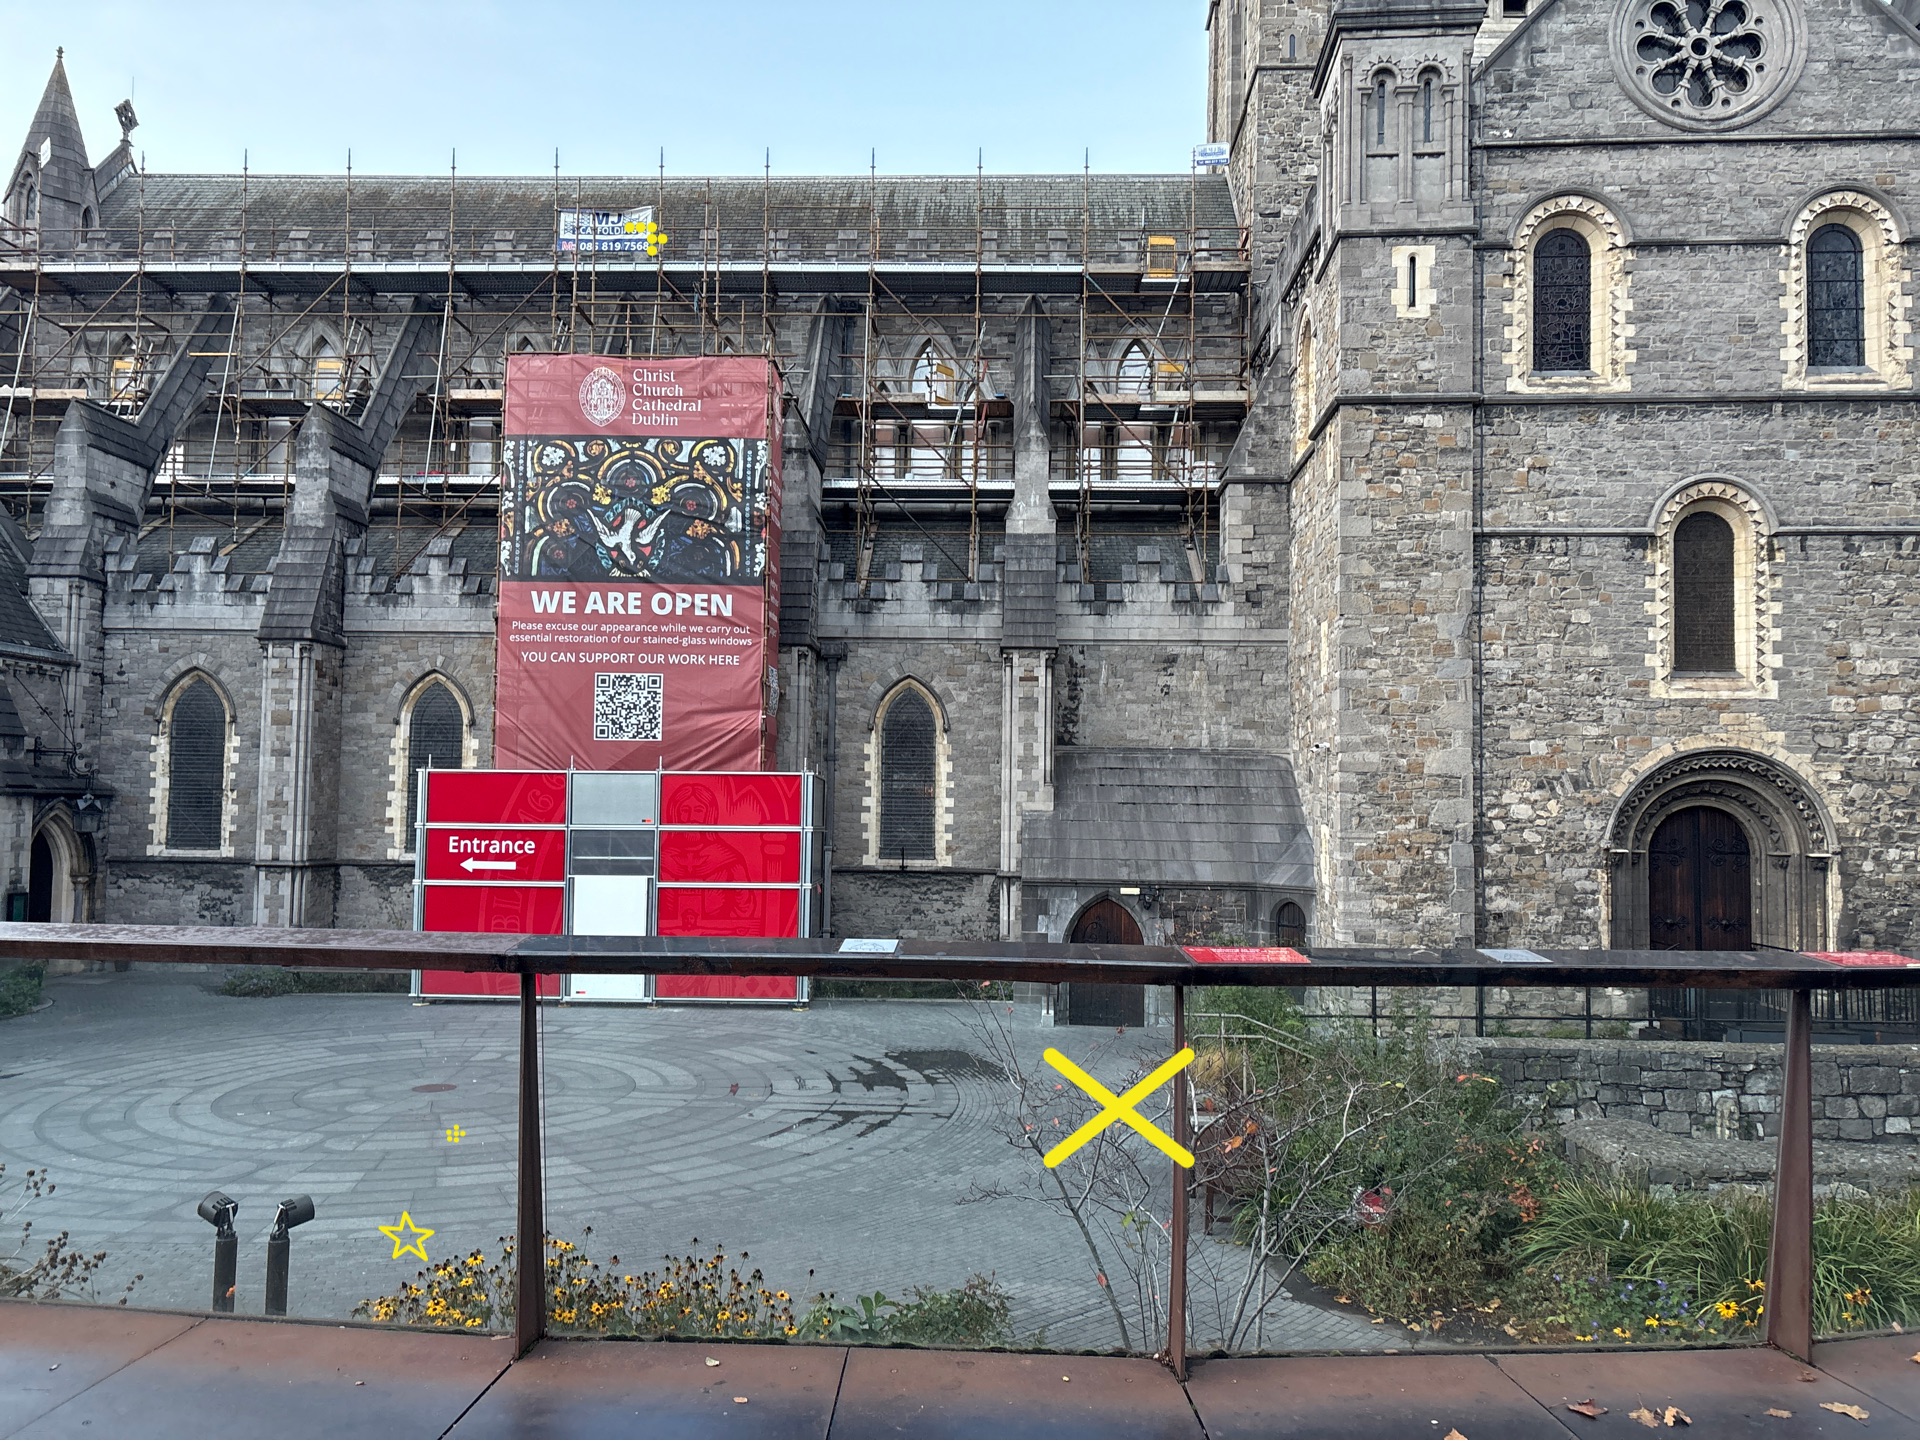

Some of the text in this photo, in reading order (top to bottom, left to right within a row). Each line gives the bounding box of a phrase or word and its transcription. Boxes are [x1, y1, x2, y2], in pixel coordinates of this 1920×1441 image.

[602, 241, 621, 251] 819
[624, 241, 649, 251] 7568
[633, 368, 676, 382] Christ
[632, 383, 683, 397] Church
[632, 398, 702, 412] Cathedral
[632, 412, 678, 426] Dublin
[530, 590, 733, 617] WE ARE OPEN
[512, 620, 751, 636] Please excuse our appearance while we carry out
[509, 633, 753, 647] essential restoration of our stained-glass windows
[521, 651, 740, 666] YOU CAN SUPPORT OUR WORK HERE
[449, 836, 536, 854] Entrance
